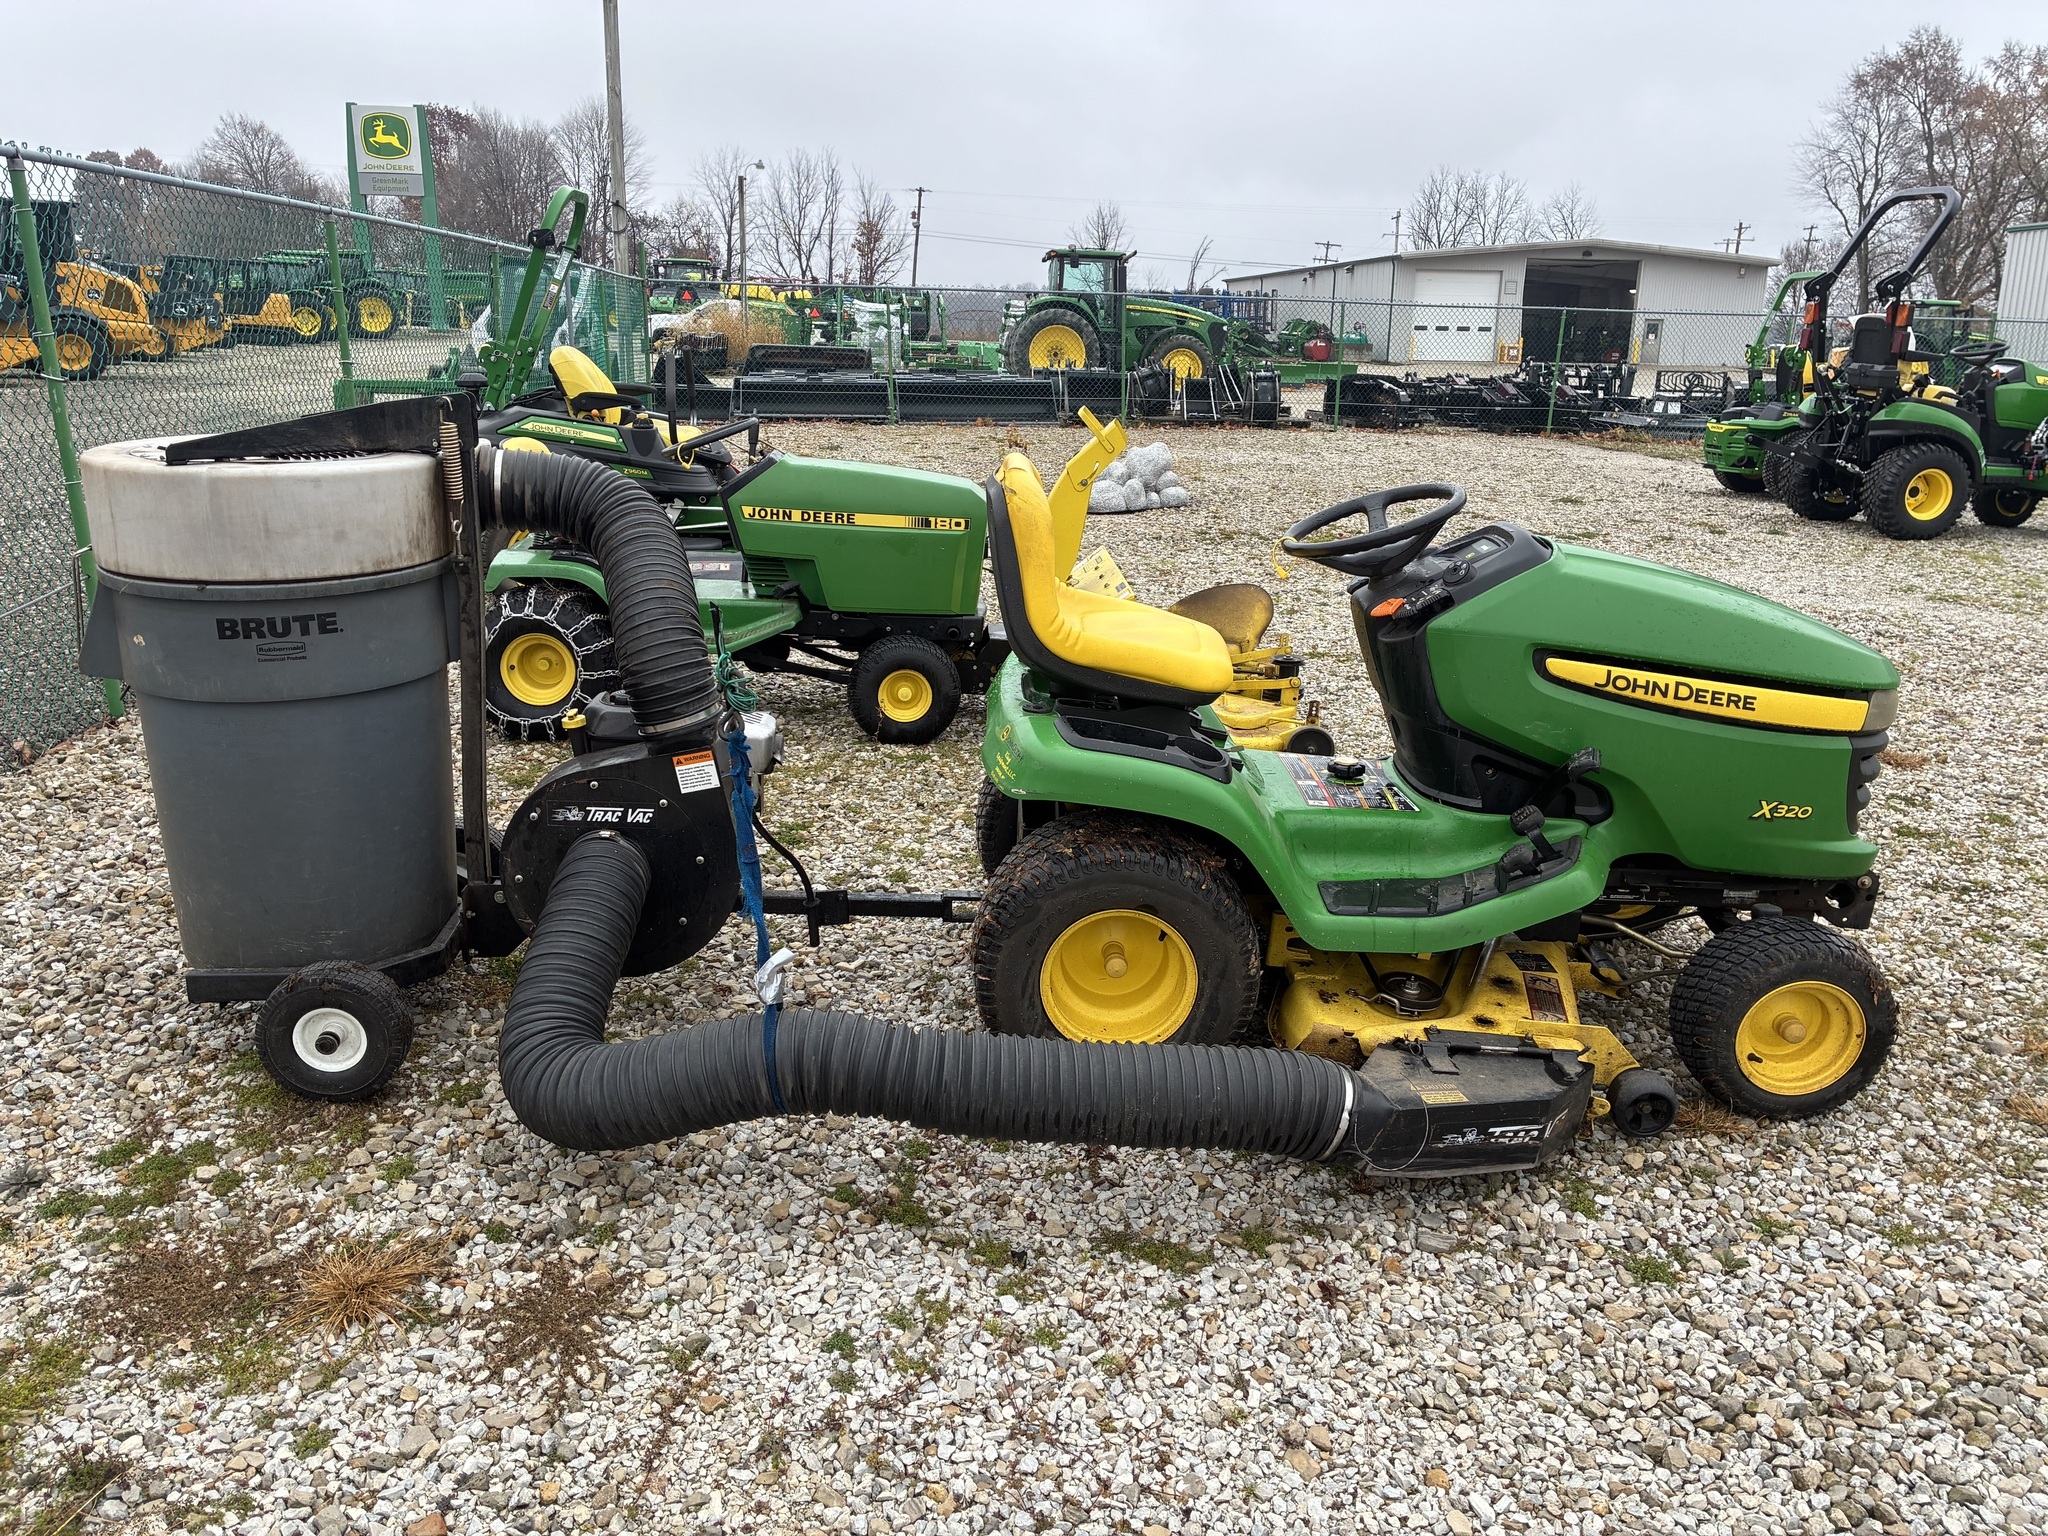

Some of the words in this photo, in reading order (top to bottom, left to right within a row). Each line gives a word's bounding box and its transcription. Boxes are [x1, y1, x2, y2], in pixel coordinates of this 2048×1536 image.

[386, 163, 414, 171] DEERE
[529, 423, 554, 432] JOHN
[554, 426, 584, 437] DEERE
[748, 507, 793, 521] JOHN
[800, 510, 856, 525] DEERE
[927, 517, 965, 530] 180
[258, 645, 304, 653] Rubbermaid
[1594, 669, 1670, 698] JOHN
[1673, 680, 1758, 712] DEERE
[683, 753, 711, 762] WARNING
[586, 807, 624, 823] TRAC
[626, 808, 655, 823] VAC
[1749, 800, 1814, 822] X320
